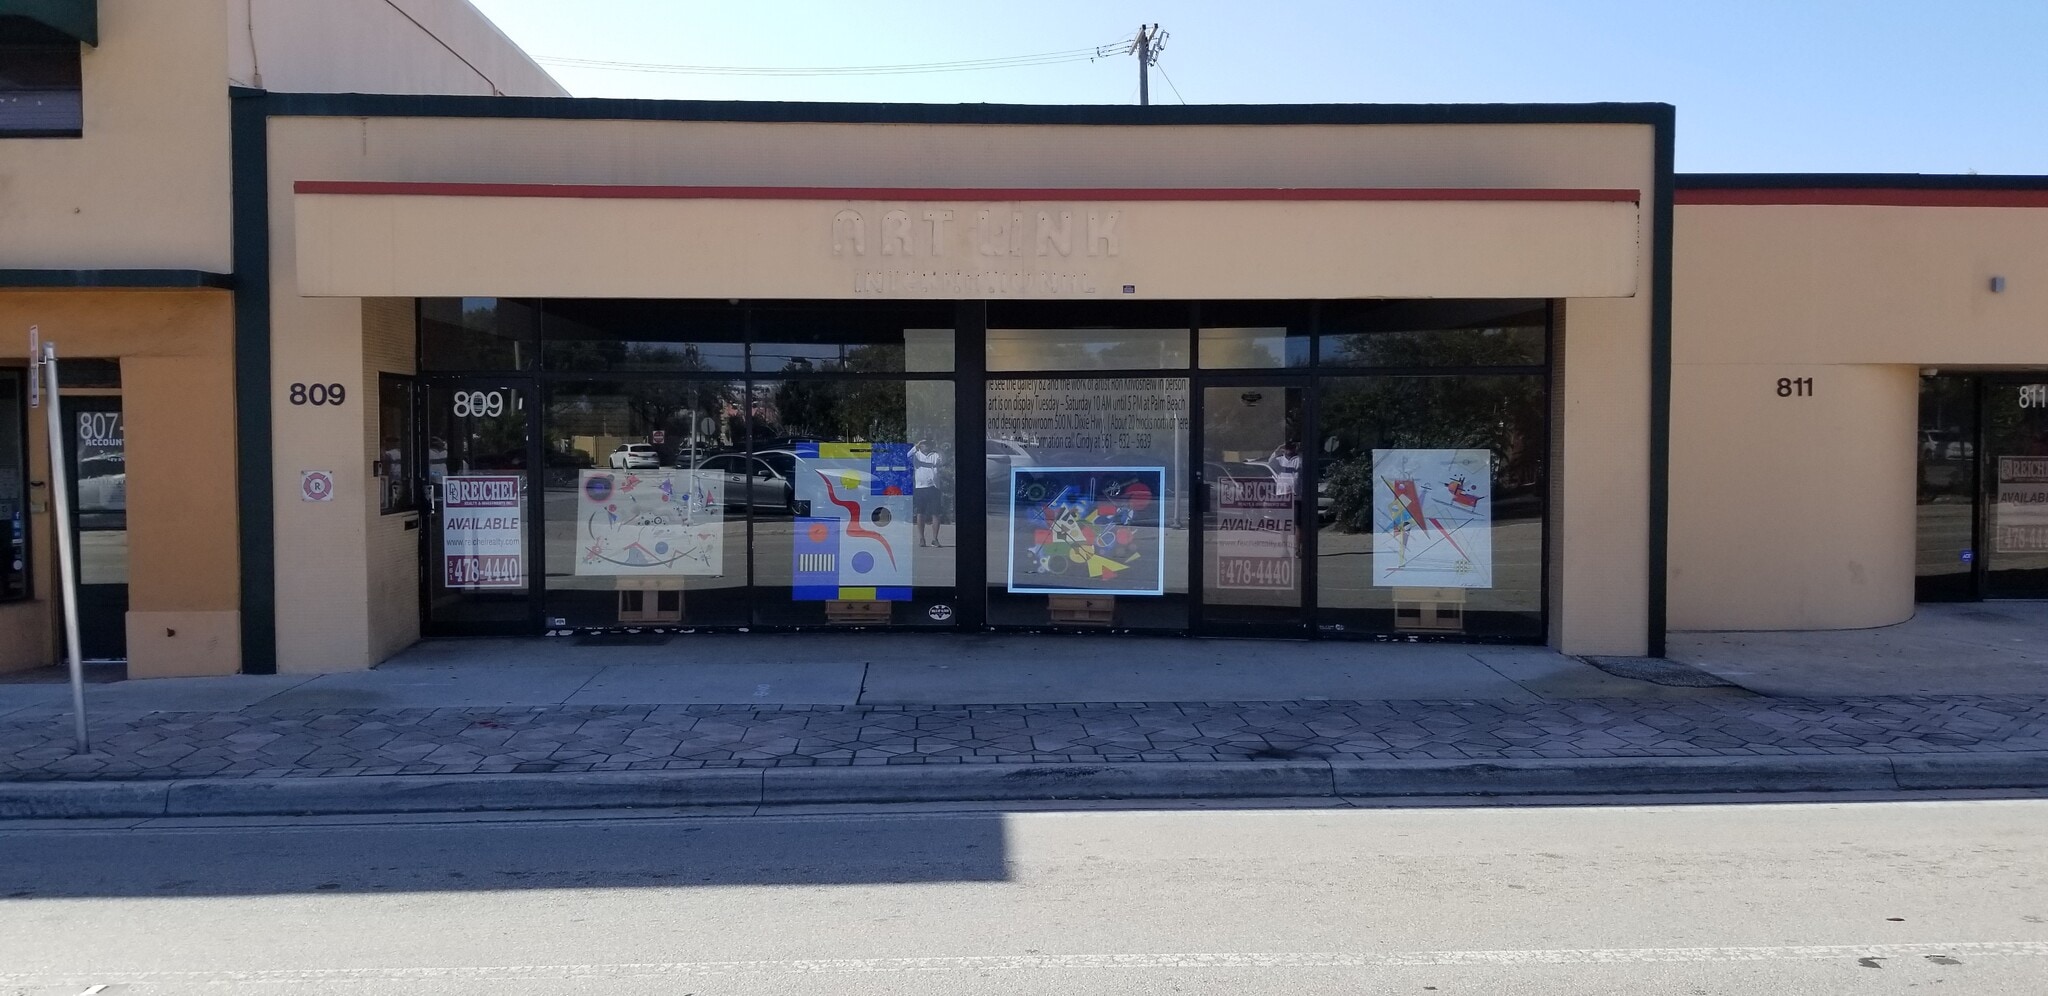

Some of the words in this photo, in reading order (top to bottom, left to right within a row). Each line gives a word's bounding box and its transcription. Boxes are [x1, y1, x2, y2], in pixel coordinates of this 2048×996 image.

[831, 208, 953, 256] ART
[289, 383, 346, 406] 809
[994, 379, 1004, 391] see
[1006, 379, 1016, 391] the
[1047, 379, 1058, 391] and
[1776, 377, 1813, 397] 811
[453, 390, 504, 418] 809
[988, 395, 997, 411] art
[998, 395, 1003, 411] is
[1004, 398, 1012, 411] on
[1013, 394, 1034, 415] display
[1035, 394, 1059, 416] Tuesday
[1065, 394, 1091, 415] Saturday
[1093, 395, 1100, 411] 10
[1101, 395, 1112, 411] AM
[1113, 394, 1127, 411] until
[1128, 395, 1132, 411] 5
[1133, 395, 1143, 411] PM
[1144, 397, 1150, 411] at
[1151, 394, 1165, 411] Palm
[1167, 394, 1186, 411] Beach
[2018, 385, 2046, 408] 811
[988, 413, 1000, 430] and
[1001, 413, 1021, 434] design
[1022, 413, 1053, 430] showroom
[1075, 413, 1090, 430] Dixie
[1076, 432, 1093, 453] Cindy
[1094, 435, 1101, 449] at
[314, 482, 321, 491] R
[461, 481, 517, 501] REICHEL
[1235, 481, 1292, 502] REICHEL
[2001, 491, 2048, 504] AVAILAB
[446, 517, 519, 530] AVAILABLE
[1219, 518, 1293, 532] AVAILABLE
[446, 537, 520, 547] www.reichelrealty.com
[454, 557, 518, 582] 478-4440
[1226, 559, 1290, 584] 478-4440
